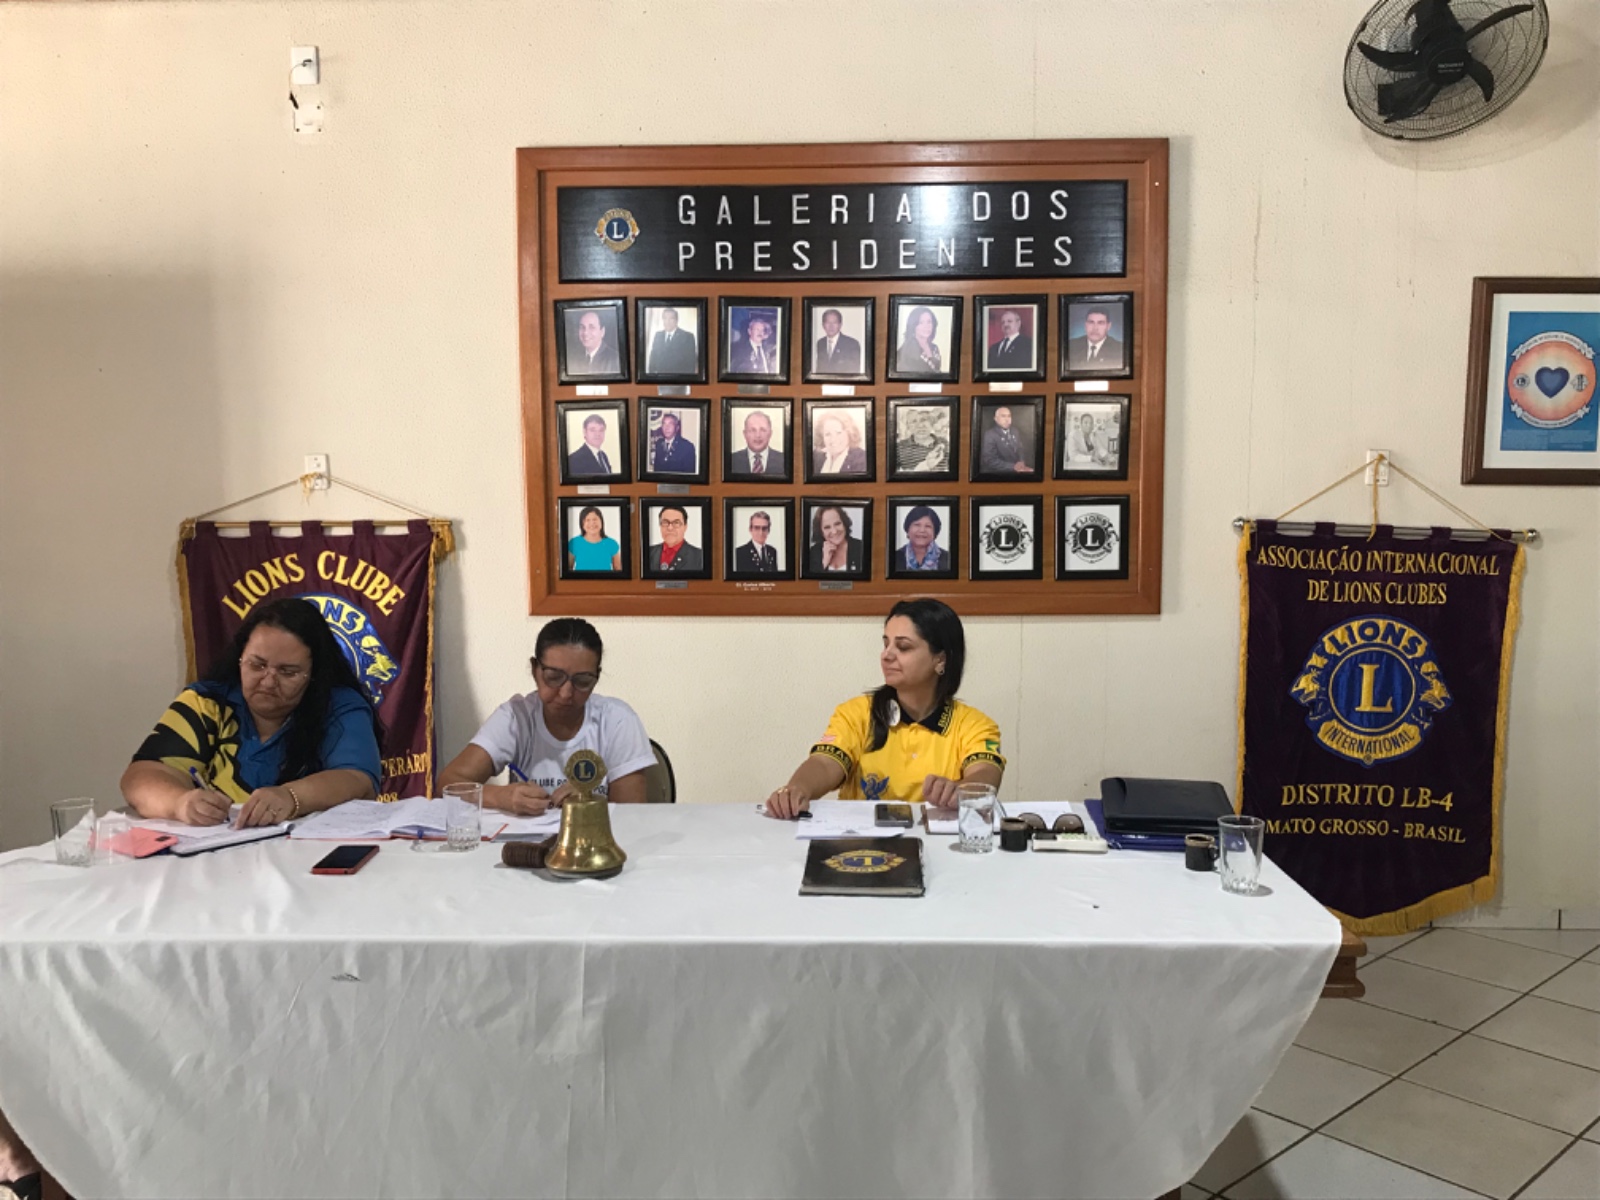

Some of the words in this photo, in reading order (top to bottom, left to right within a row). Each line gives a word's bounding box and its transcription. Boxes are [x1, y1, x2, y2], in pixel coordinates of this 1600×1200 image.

[678, 192, 912, 226] GALERIA
[972, 189, 1069, 222] DOS
[612, 221, 625, 239] L
[678, 236, 1073, 272] PRESIDENTES
[999, 528, 1014, 547] L
[1085, 528, 1100, 547] L
[1257, 545, 1363, 575] ASSOCIAÇÃO
[1366, 550, 1500, 576] INTERNACIONAL
[222, 553, 306, 620] LIONS
[317, 550, 406, 617] CLUBE
[1307, 578, 1330, 602] DE
[1333, 580, 1382, 604] LIONS
[1385, 582, 1447, 605] CLUBES
[1328, 620, 1423, 656] LIONS
[1355, 664, 1393, 712] L
[1325, 725, 1415, 755] INTERNATIONAL
[579, 762, 592, 778] L
[1281, 784, 1395, 807] DISTRITO
[1401, 787, 1453, 812] LB-4
[1266, 817, 1315, 834] MATO
[1319, 818, 1390, 836] GROSSO
[1403, 822, 1466, 844] BRASIL
